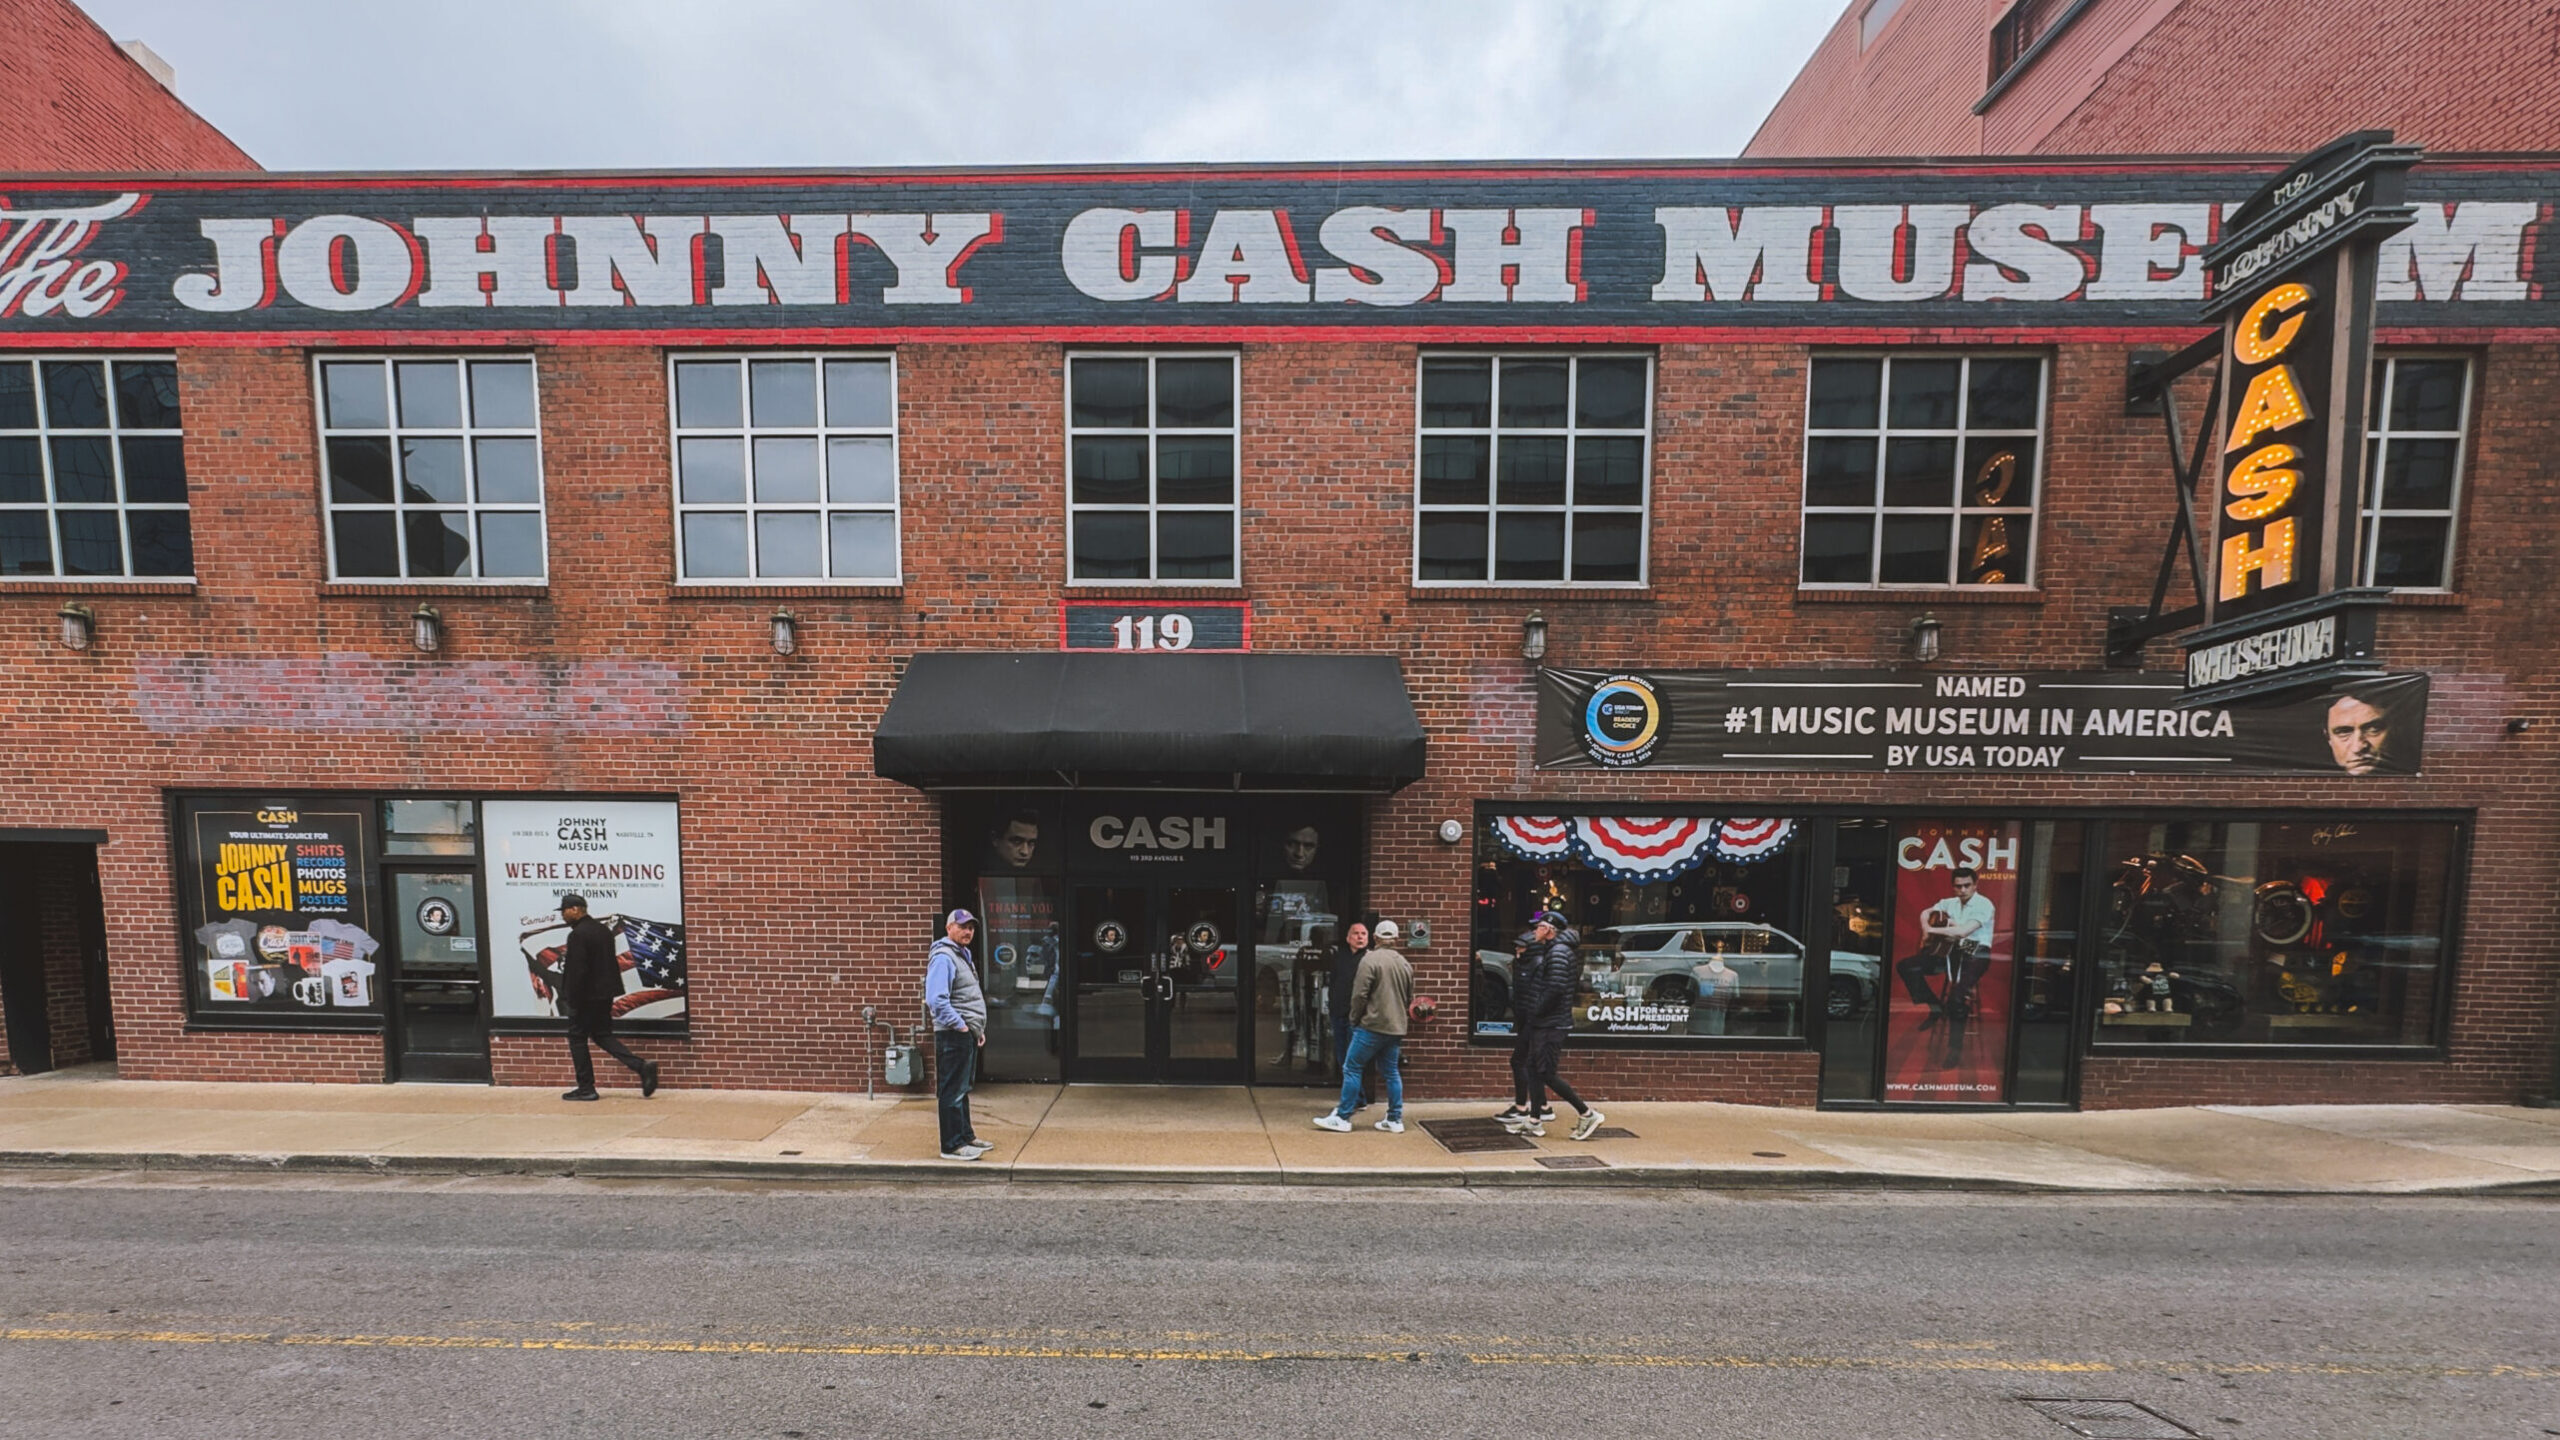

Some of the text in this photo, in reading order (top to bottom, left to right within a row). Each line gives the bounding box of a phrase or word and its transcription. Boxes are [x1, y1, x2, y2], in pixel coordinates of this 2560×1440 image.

[2214, 180, 2366, 291] JOHNNY
[0, 192, 2540, 318] The JOHNNY CASH MUSEM
[2220, 283, 2313, 602] CASH
[1112, 613, 1194, 650] 119
[2188, 616, 2336, 688] MUSEUM
[1935, 676, 2026, 698] NAMED
[1723, 706, 2235, 738] #1 MUSIC MUSEUM IN AMERICA
[1886, 745, 2065, 768] BY USA TODAY
[256, 810, 299, 824] CASH
[558, 817, 607, 827] JOHNNY
[228, 831, 329, 841] YOUR ULTIMATE SOURCE FOR
[557, 827, 607, 841] CASH
[1089, 815, 1226, 849] CASH
[1917, 828, 1999, 836] JOHNNY
[296, 844, 345, 857] SHIRTS
[558, 842, 609, 851] MUSEUM
[1897, 836, 2018, 870] CASH
[215, 842, 288, 877] JOHNNY
[296, 857, 346, 868] RECORDS
[296, 868, 347, 880] PHOTOS
[505, 862, 665, 880] WE'RE EXPANDING
[1979, 872, 2016, 880] MUSEUM
[216, 860, 294, 912] CASH
[299, 880, 348, 895] MUGS
[299, 895, 348, 905] POSTERS
[582, 889, 619, 899] JOHNNY
[989, 902, 1054, 914] THANK YOU
[520, 913, 557, 926] Coming
[1587, 1005, 1640, 1021] CASH
[1640, 1006, 1658, 1014] FOR
[1640, 1014, 1689, 1022] PRESIDENT
[1886, 1083, 1997, 1092] WWW.CASHMUSEUM.COM
